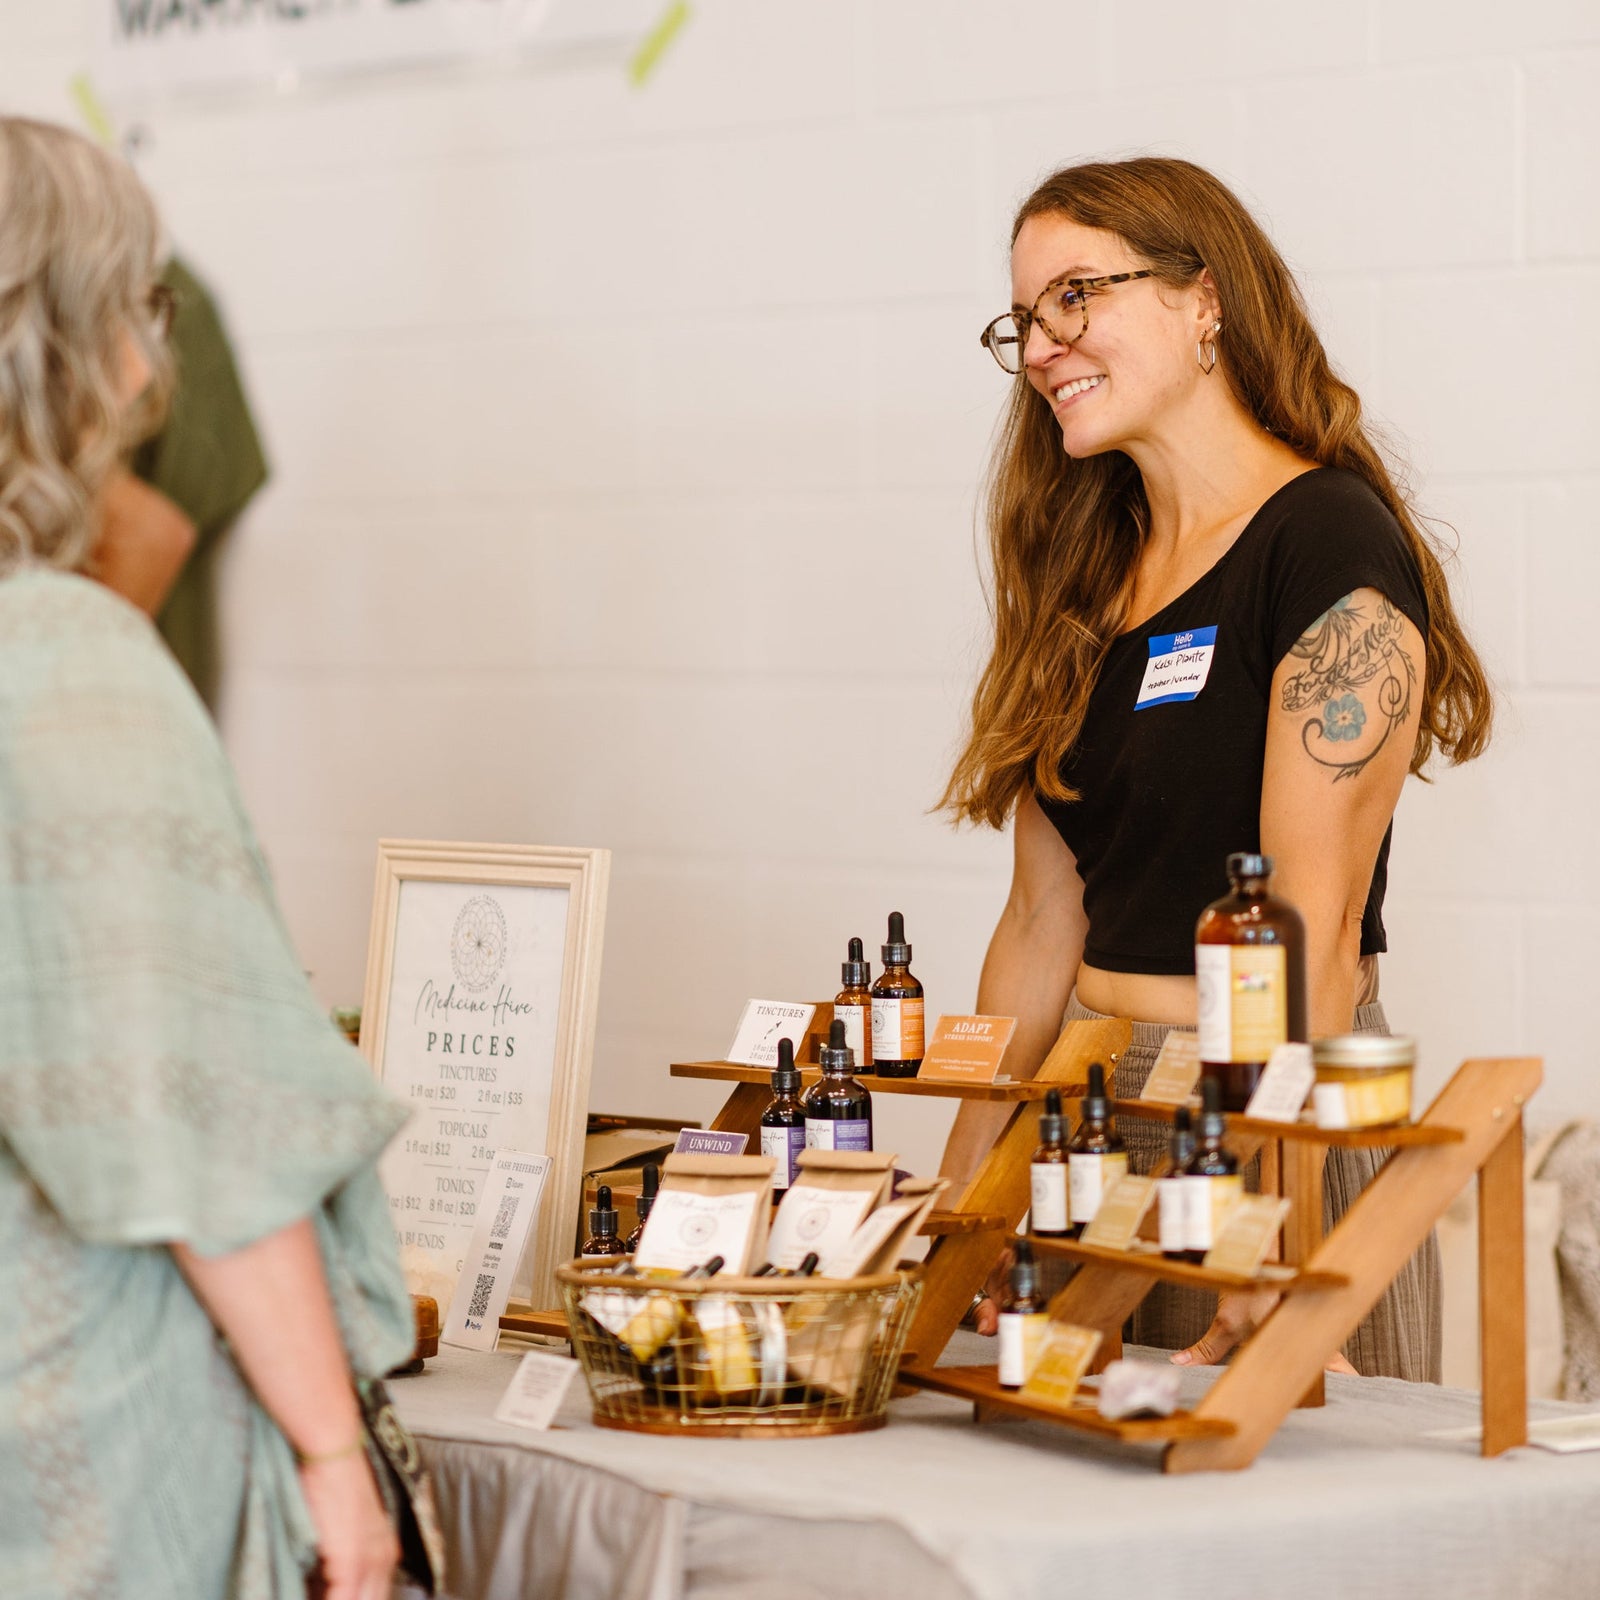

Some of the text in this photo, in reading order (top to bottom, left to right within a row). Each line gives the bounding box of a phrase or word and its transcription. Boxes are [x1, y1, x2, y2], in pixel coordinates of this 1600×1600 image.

[1173, 632, 1193, 646] Hello
[1153, 650, 1205, 672] Kelsi Plante
[414, 979, 533, 1027] Medicine Hive
[756, 1006, 805, 1019] TINCTURES
[952, 1022, 992, 1034] ADAPT
[427, 1031, 515, 1058] PRICES
[439, 1064, 497, 1082] TINCTURES
[425, 1088, 434, 1098] oz
[440, 1086, 456, 1100] $20
[478, 1089, 484, 1102] 2
[492, 1093, 502, 1104] oz
[508, 1092, 523, 1105] $35
[439, 1120, 488, 1139] TOPICALS
[420, 1144, 429, 1154] oz
[435, 1142, 451, 1156] $12
[472, 1145, 478, 1159] 2
[485, 1149, 496, 1160] oz
[690, 1138, 732, 1152] UNWIND
[497, 1160, 543, 1175] CASH PREFERRED
[436, 1177, 475, 1195] TONICS
[406, 1196, 420, 1210] $12
[444, 1203, 454, 1213] oz
[460, 1202, 476, 1216] $20
[405, 1231, 445, 1250] BLENDS
